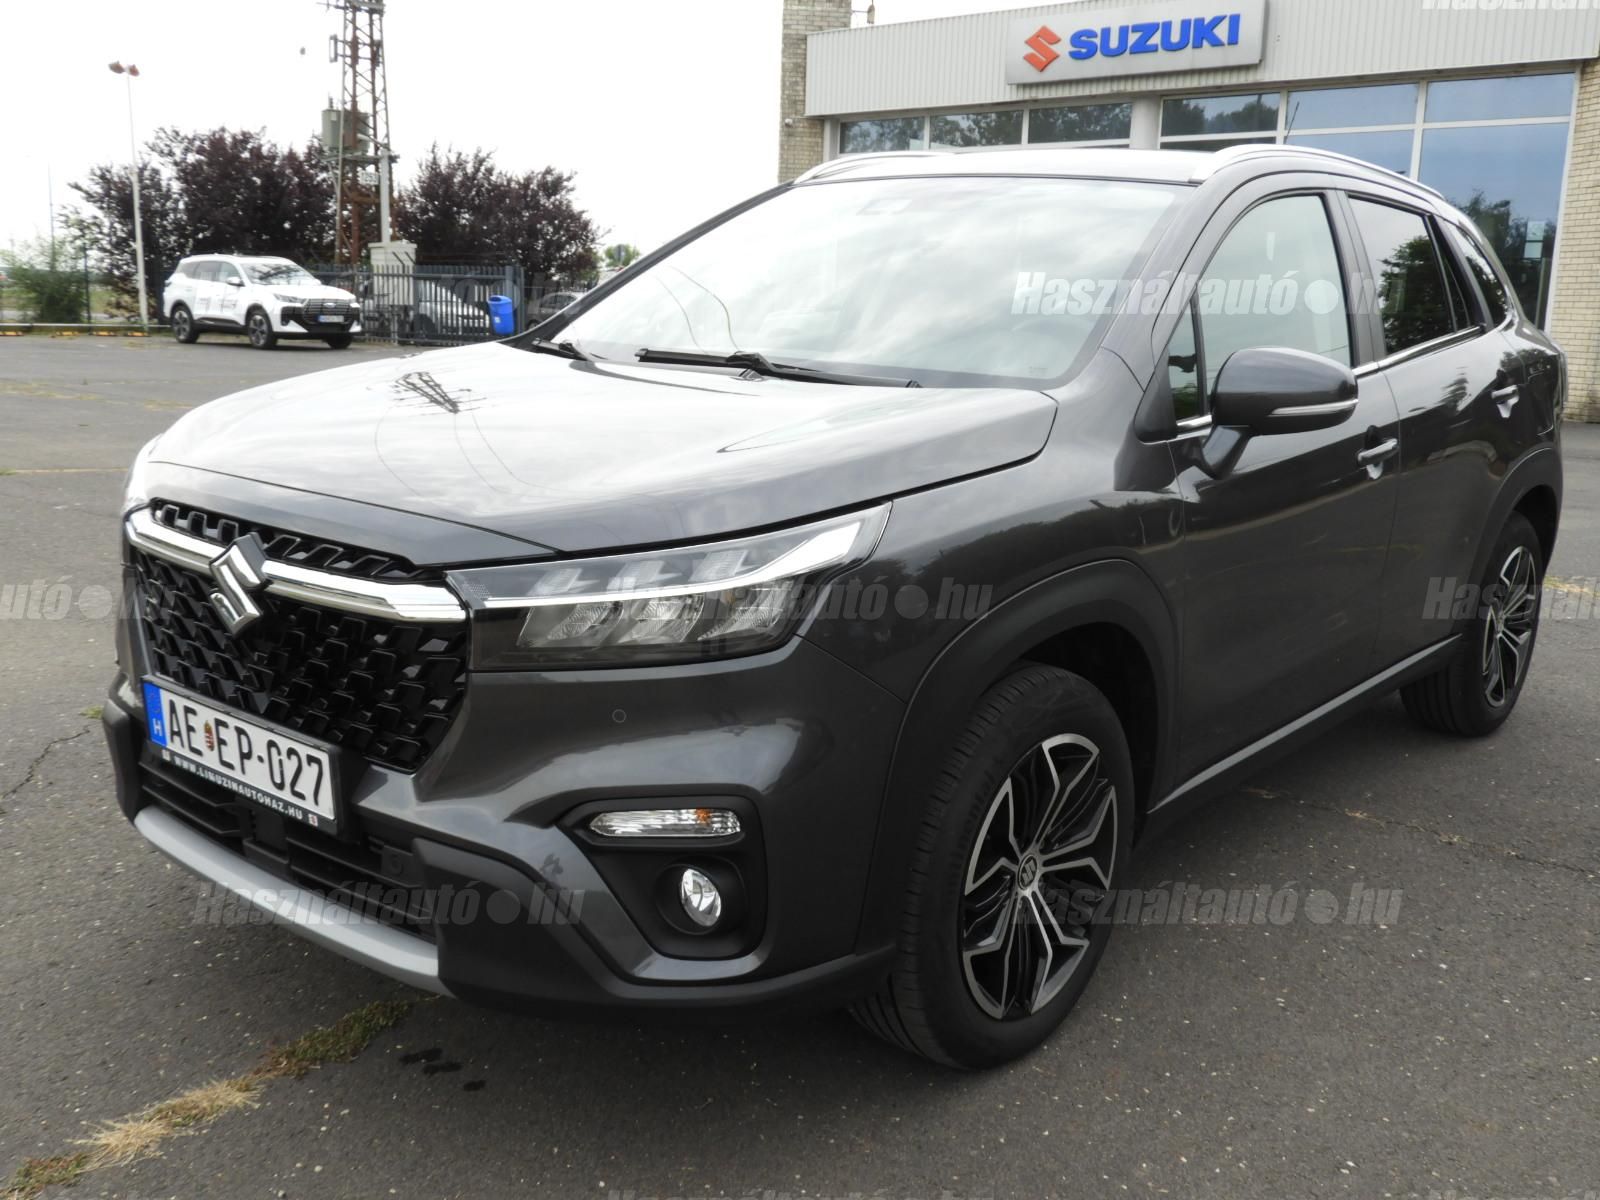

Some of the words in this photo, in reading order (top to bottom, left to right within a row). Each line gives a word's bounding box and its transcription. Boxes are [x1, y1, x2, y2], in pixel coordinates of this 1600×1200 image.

[1068, 13, 1241, 61] SUZUKI
[152, 718, 163, 737] H
[169, 698, 204, 758] AE
